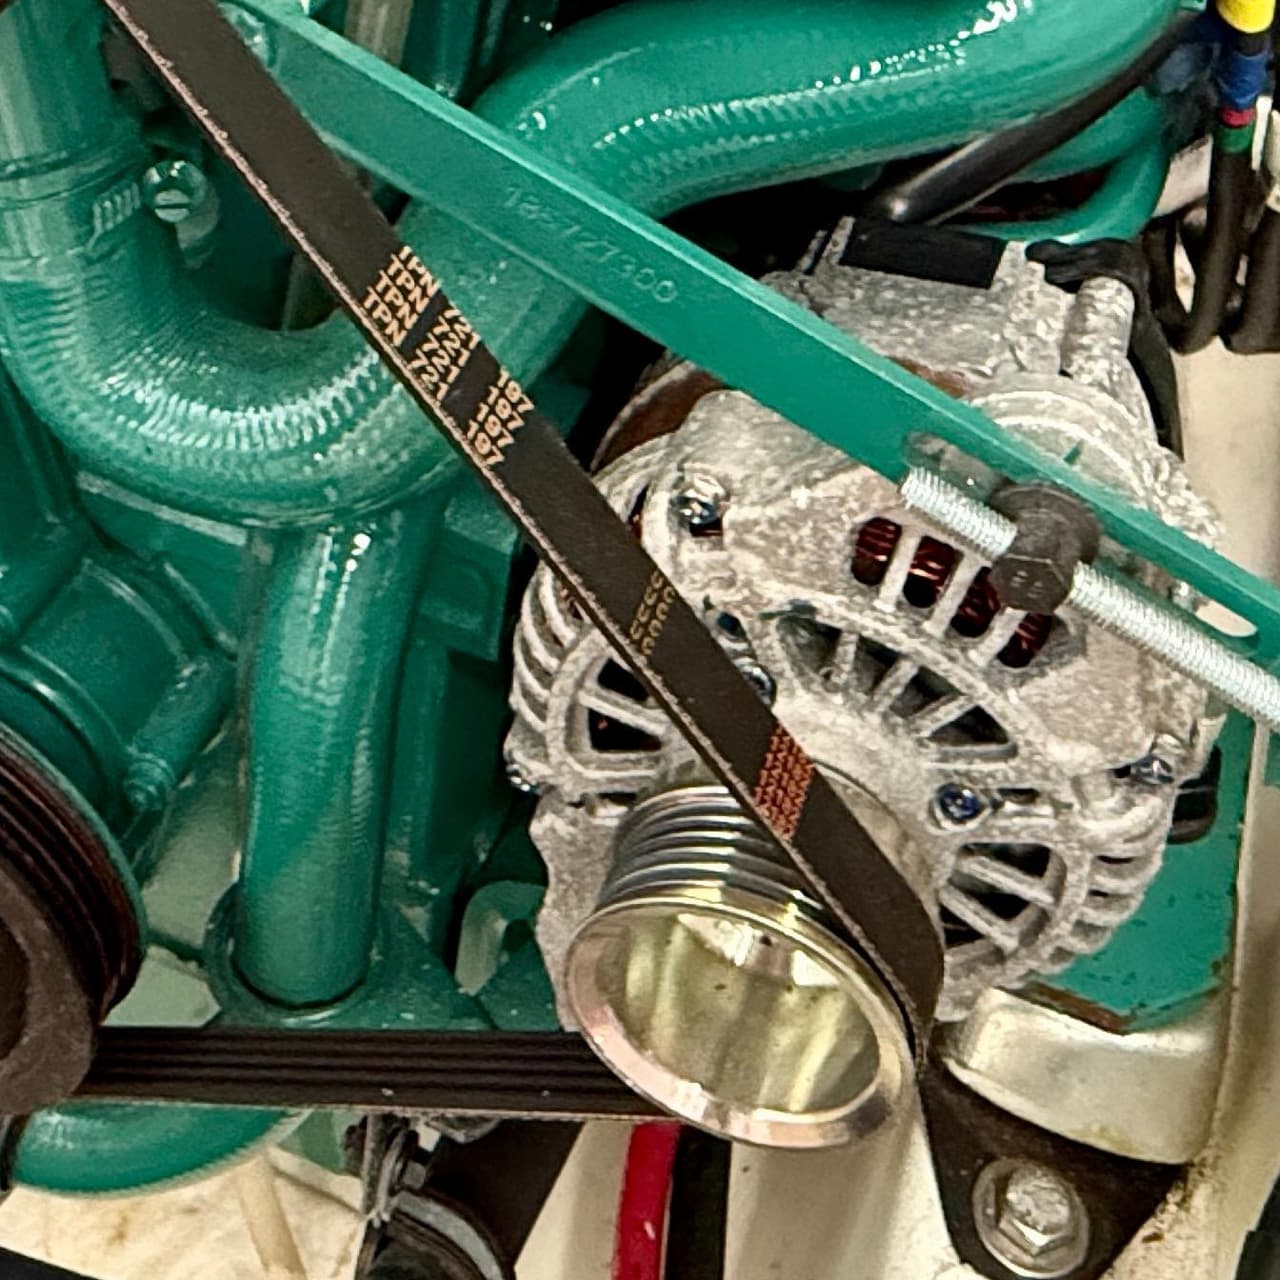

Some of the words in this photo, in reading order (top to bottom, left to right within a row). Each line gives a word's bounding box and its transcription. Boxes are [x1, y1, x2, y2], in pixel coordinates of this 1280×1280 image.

[363, 285, 408, 347] TPN
[406, 348, 449, 402] 721
[375, 269, 419, 331] TPN
[421, 332, 460, 384] 721
[386, 253, 432, 314] TPN
[432, 314, 471, 368] 721
